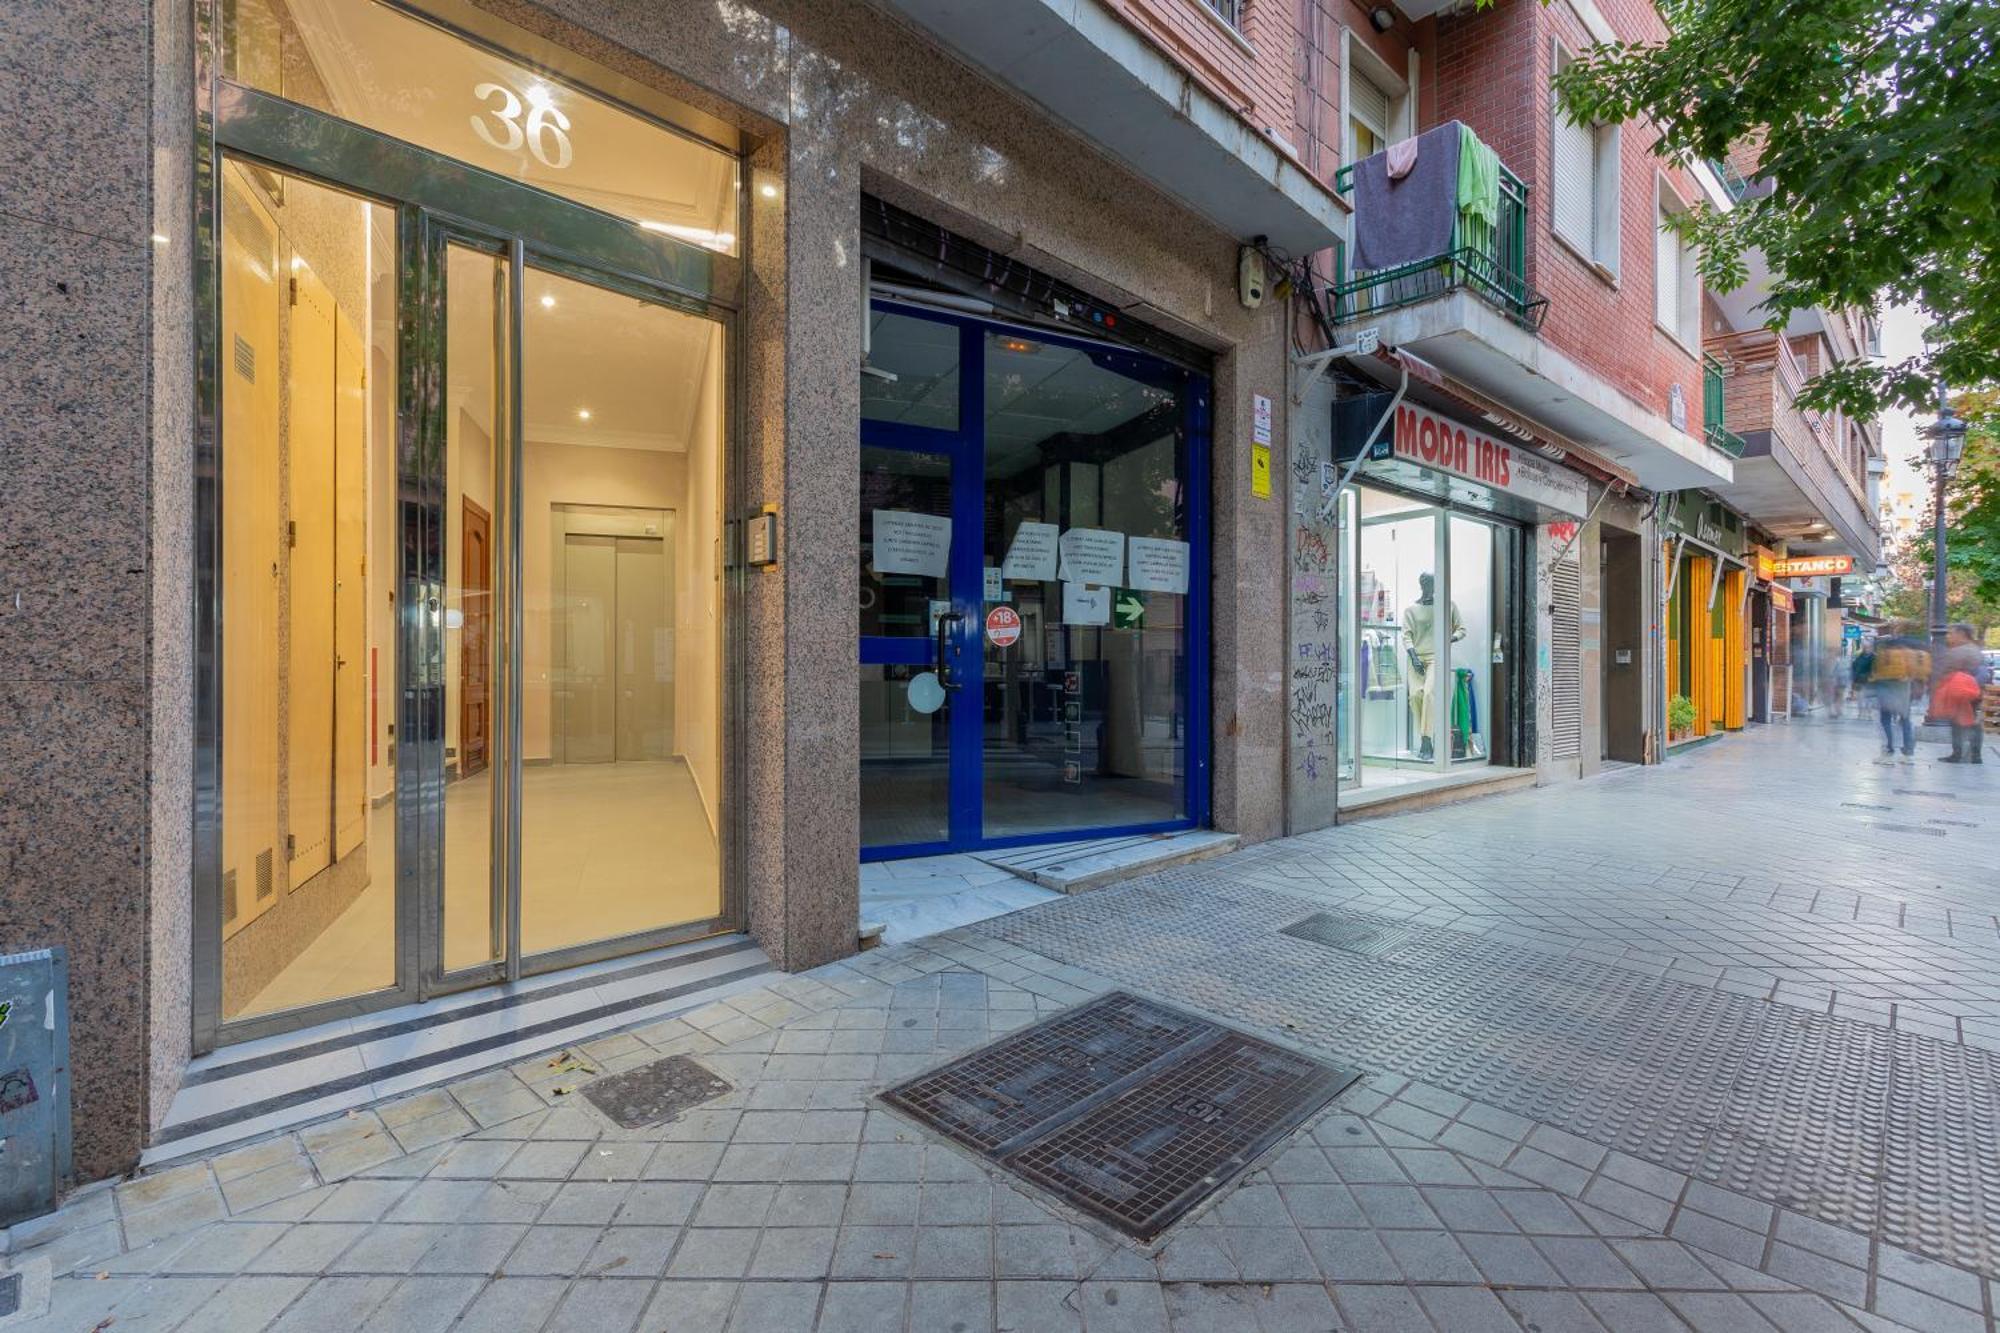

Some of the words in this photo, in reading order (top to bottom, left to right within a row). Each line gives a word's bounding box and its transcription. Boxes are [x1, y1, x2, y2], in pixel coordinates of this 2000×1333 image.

[470, 82, 573, 169] 36
[1395, 404, 1468, 474] MODA
[1475, 436, 1511, 487] IRIS
[1773, 559, 1847, 573] ESTANCO
